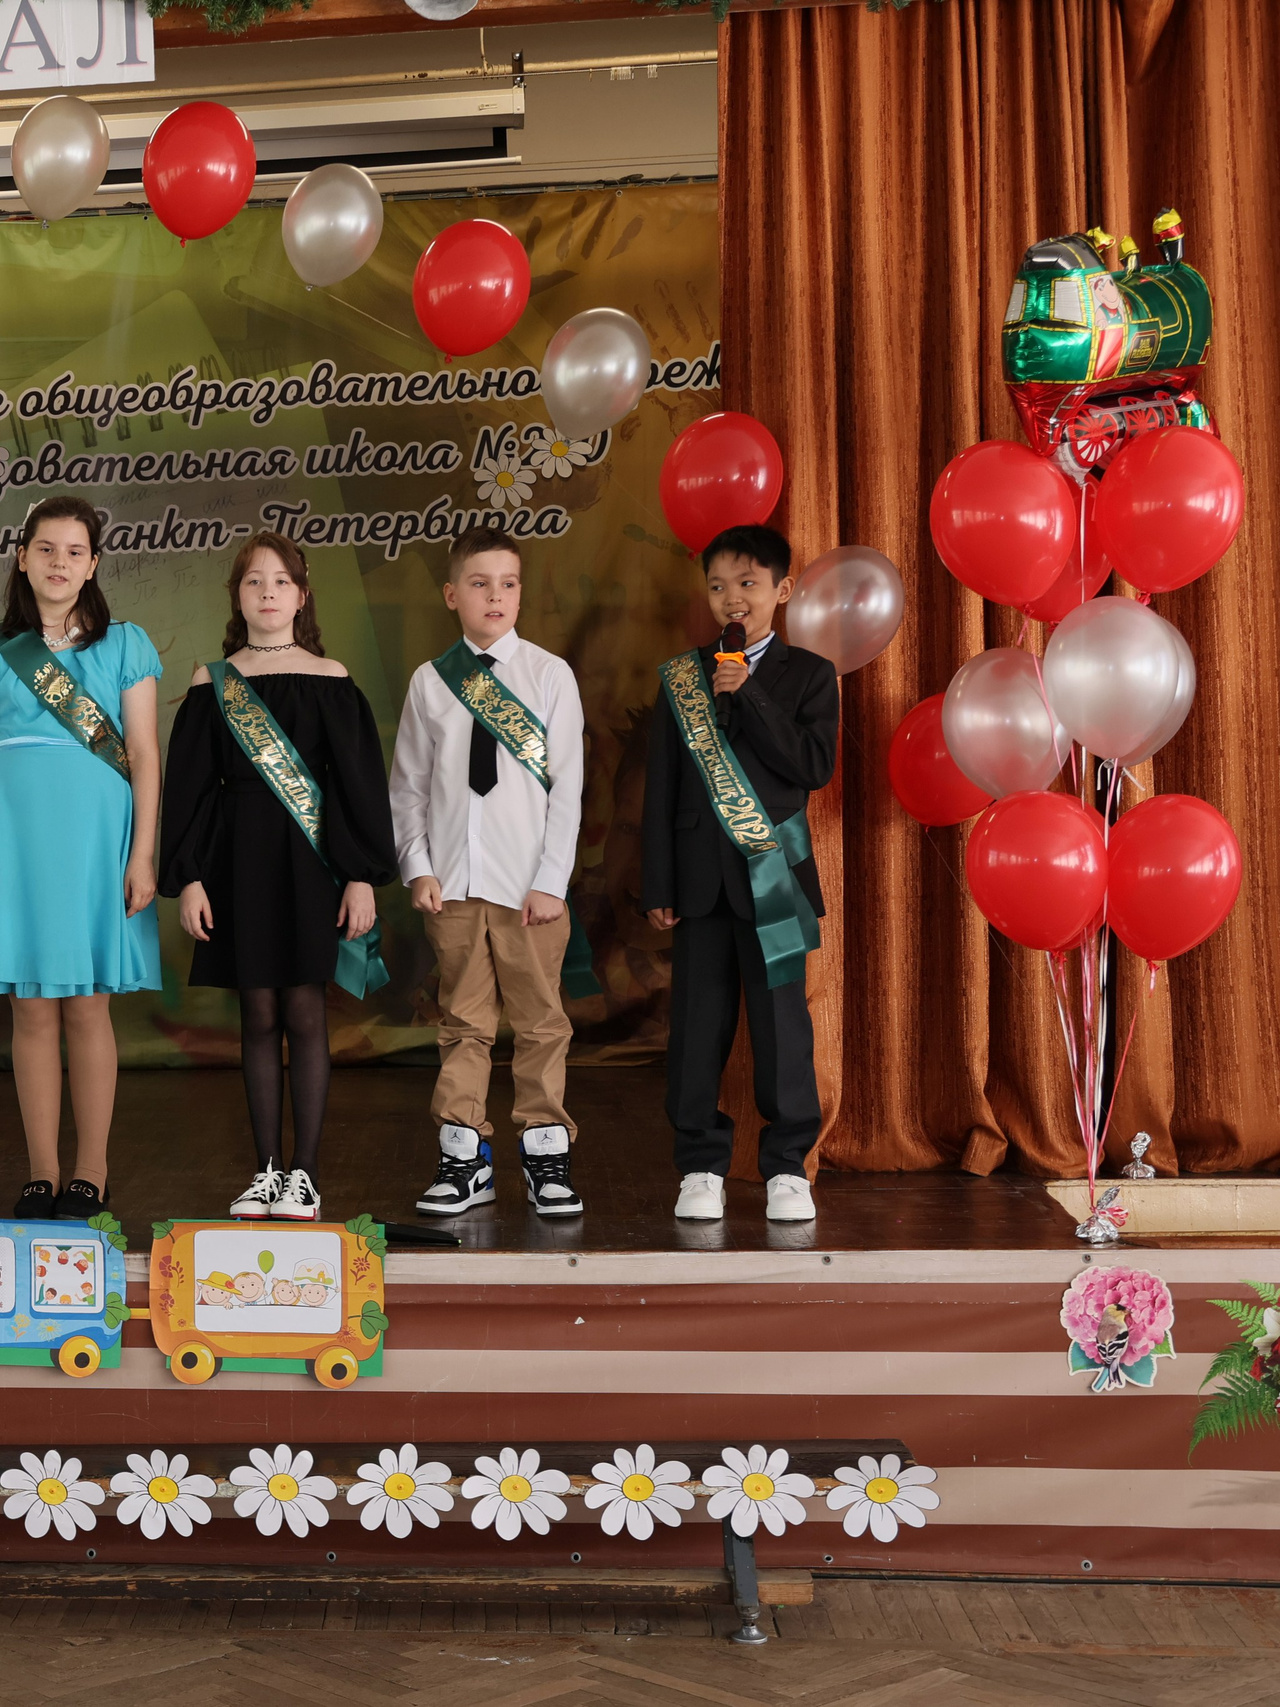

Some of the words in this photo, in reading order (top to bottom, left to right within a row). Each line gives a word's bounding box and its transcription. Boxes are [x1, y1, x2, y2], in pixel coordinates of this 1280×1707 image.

[21, 361, 542, 422] общеобразовательно
[306, 432, 459, 475] школа
[230, 703, 314, 814] Выпускник
[679, 688, 739, 803] Выпускник
